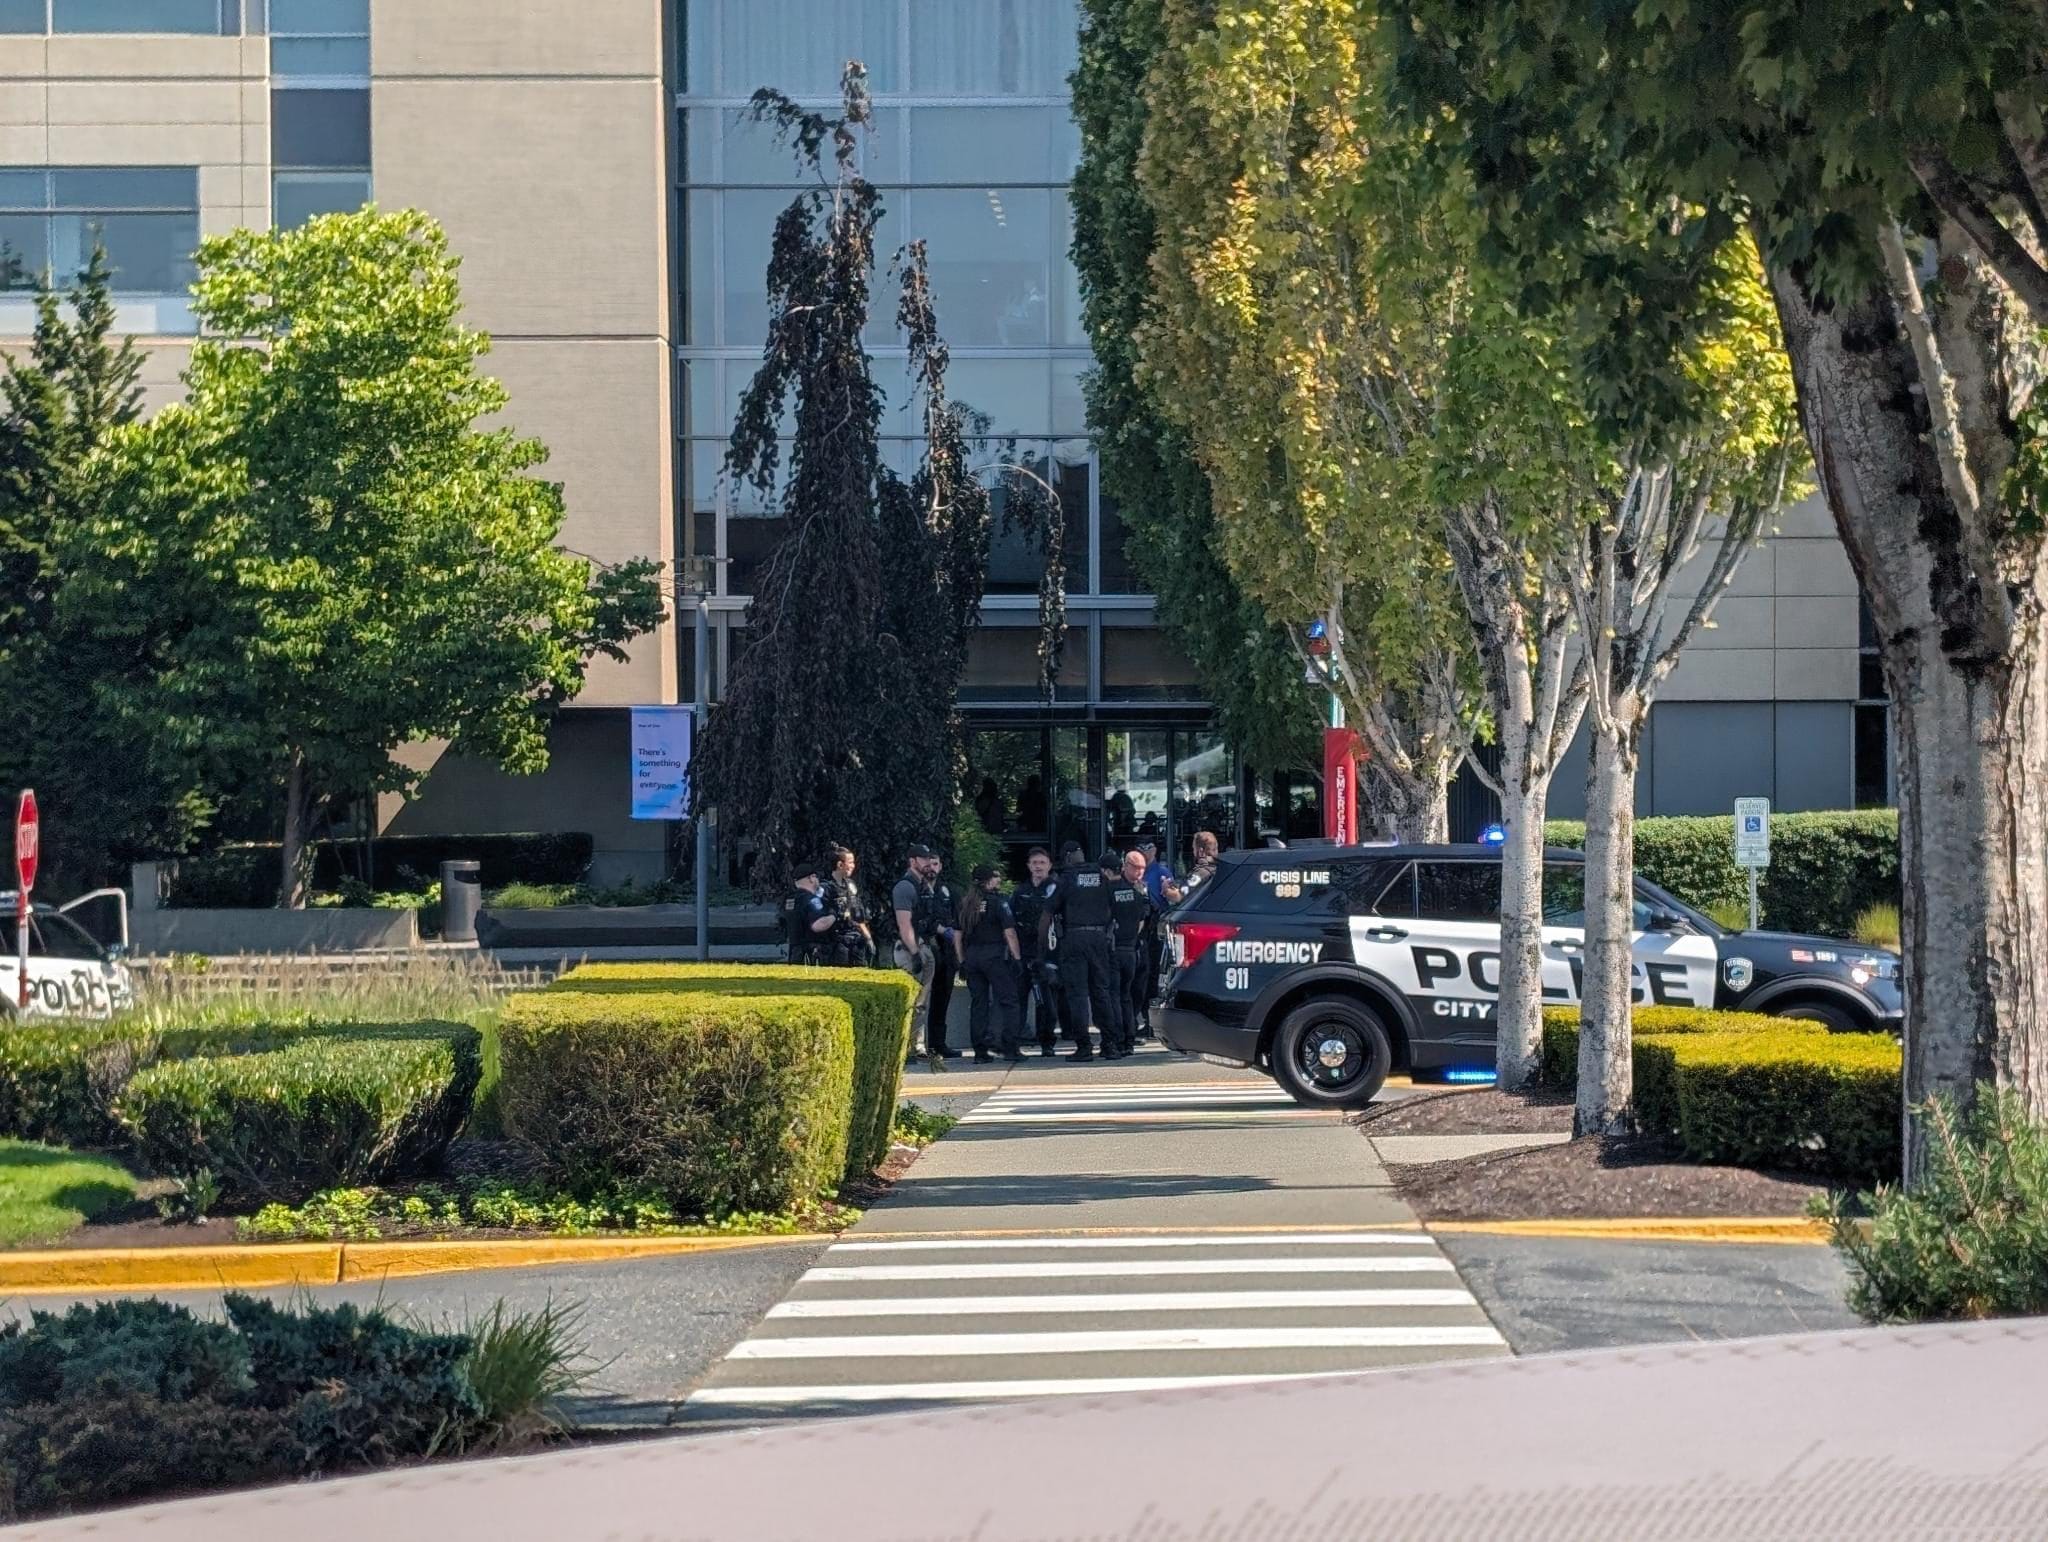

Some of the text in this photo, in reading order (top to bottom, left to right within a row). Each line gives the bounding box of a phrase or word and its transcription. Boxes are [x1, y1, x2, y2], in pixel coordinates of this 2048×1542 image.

[638, 748, 666, 756] There's
[639, 759, 681, 768] something
[639, 770, 651, 778] for
[20, 823, 36, 860] STOP
[1078, 877, 1101, 887] POLICE
[1260, 871, 1330, 884] CRISIS LINE
[1115, 893, 1135, 902] POLICE
[1215, 941, 1324, 965] EMERGENCY
[1225, 967, 1249, 990] 911
[1433, 1000, 1492, 1020] CITY
